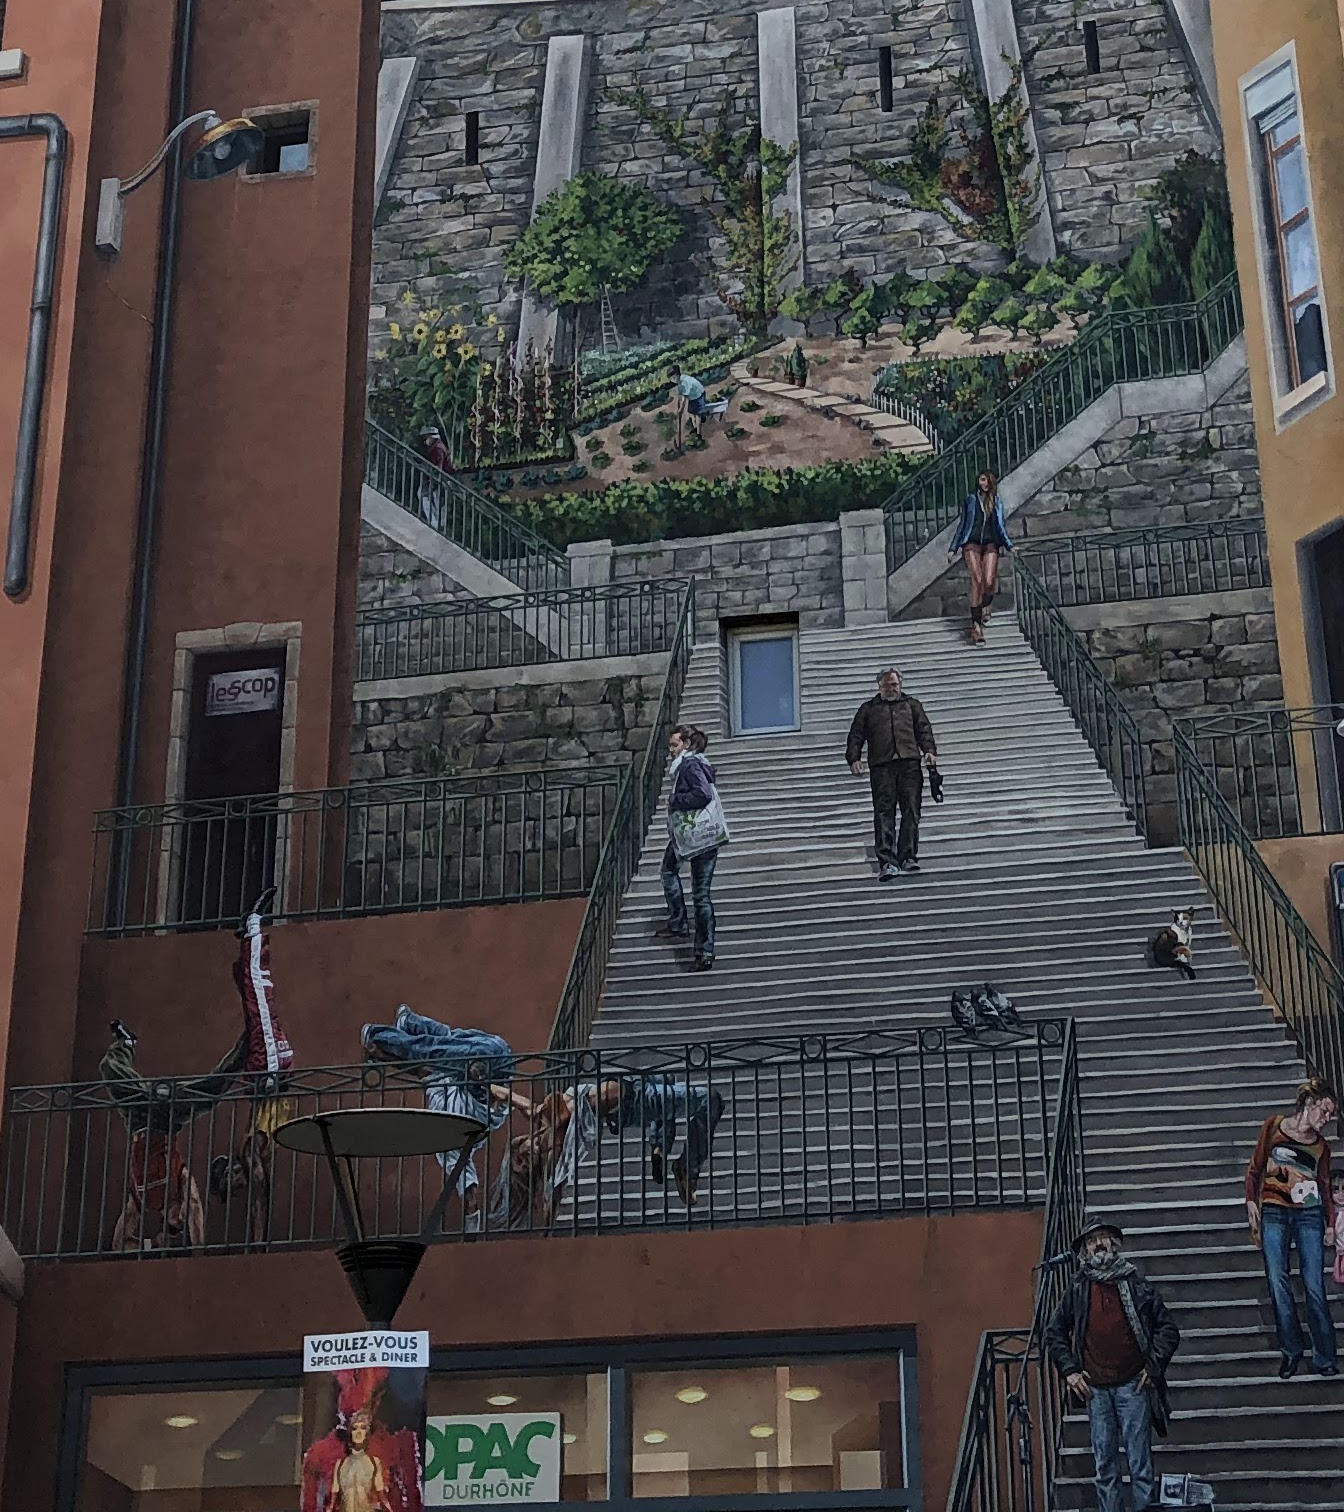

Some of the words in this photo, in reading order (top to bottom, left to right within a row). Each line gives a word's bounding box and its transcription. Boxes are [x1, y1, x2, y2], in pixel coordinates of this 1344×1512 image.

[310, 1335, 419, 1354] VOULEZ-VOUS
[310, 1354, 366, 1367] SPECTACLE
[368, 1353, 378, 1362] &
[381, 1351, 419, 1363] DINER
